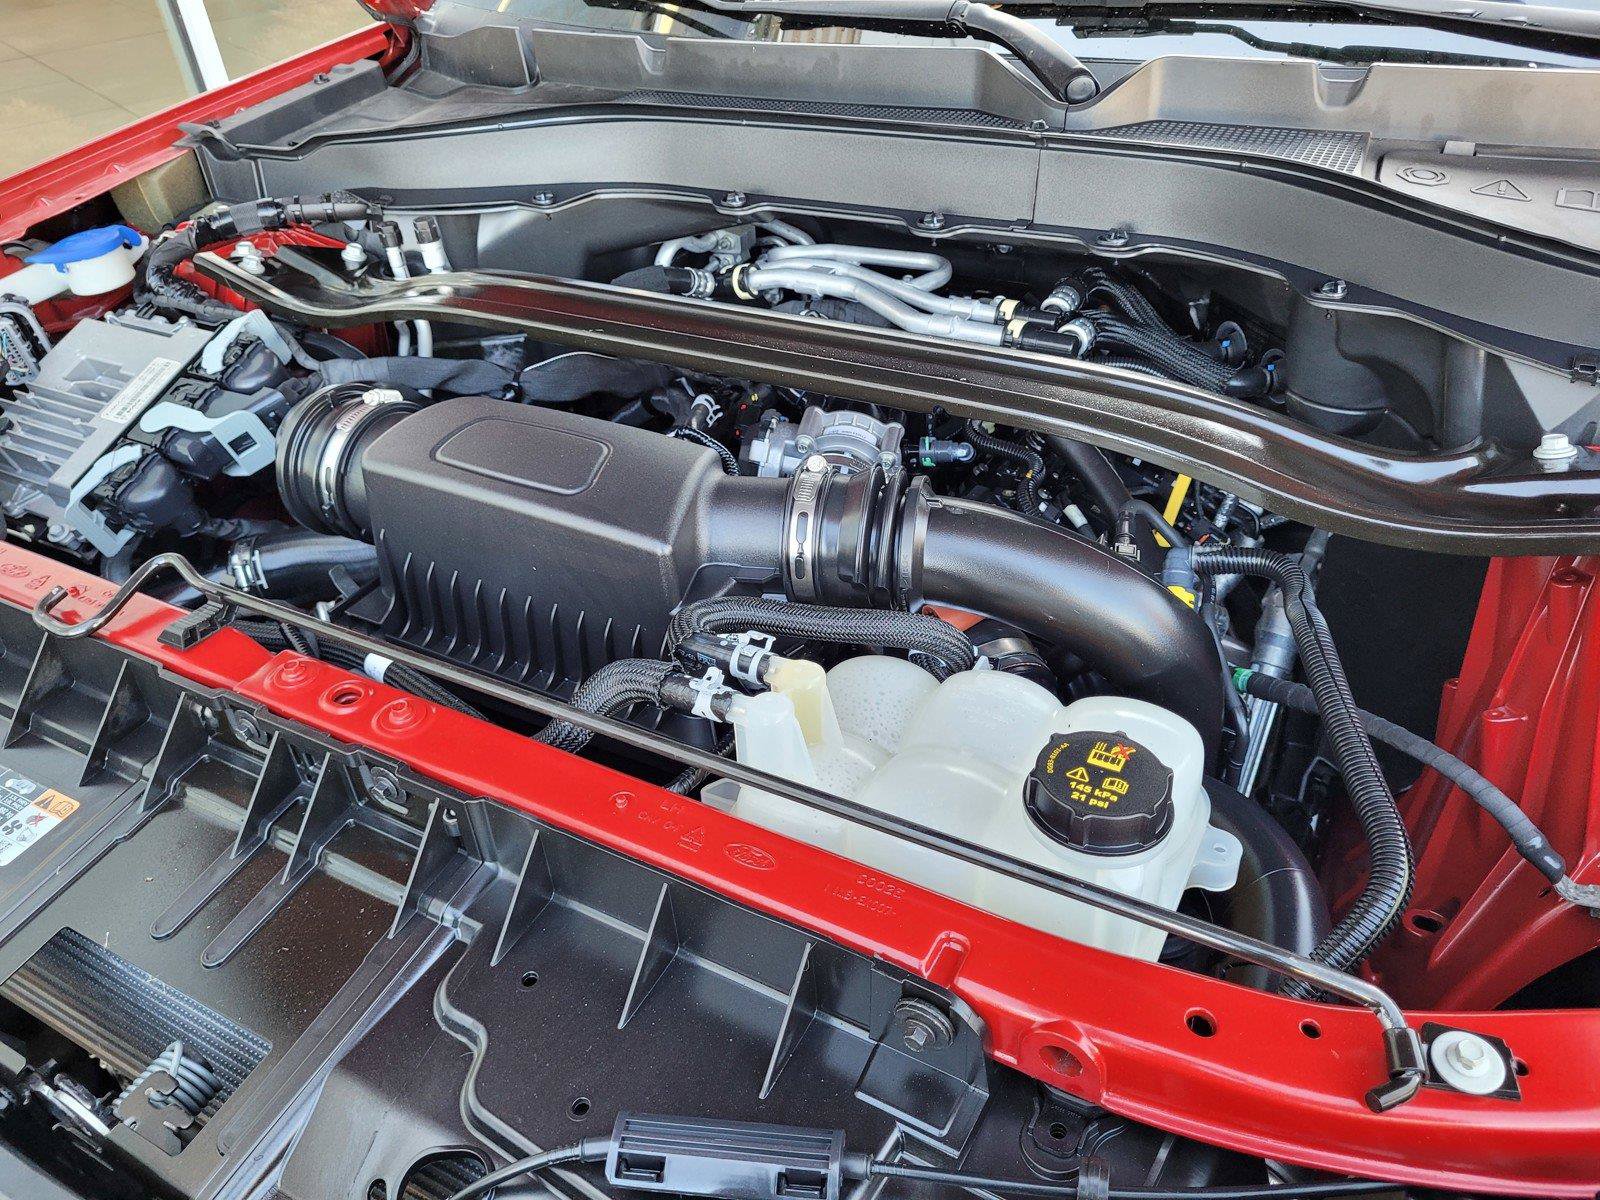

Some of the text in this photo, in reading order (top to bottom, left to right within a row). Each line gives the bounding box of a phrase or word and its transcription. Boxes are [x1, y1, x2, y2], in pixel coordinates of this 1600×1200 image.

[1069, 781, 1118, 802] 145 kPa
[1070, 791, 1109, 809] 21 psi
